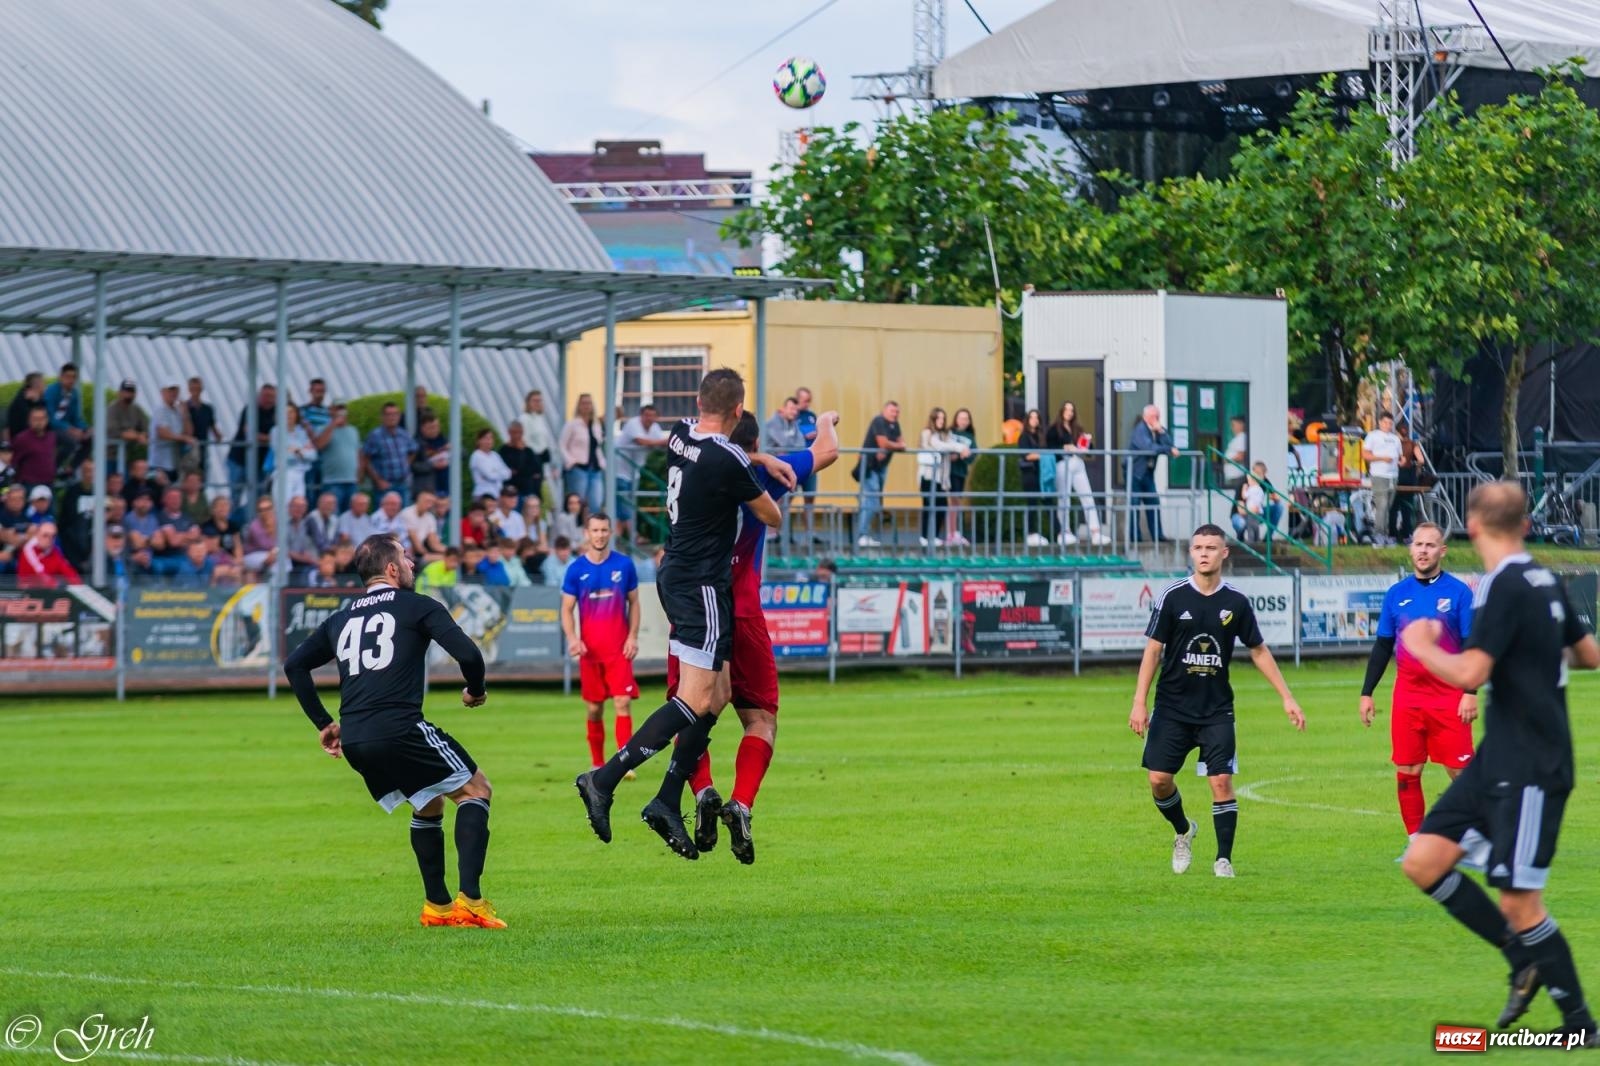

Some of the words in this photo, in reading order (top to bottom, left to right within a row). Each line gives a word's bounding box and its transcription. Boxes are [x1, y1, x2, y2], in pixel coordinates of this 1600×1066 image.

[666, 465, 683, 525] 8
[350, 590, 396, 611] LUBOMIA
[975, 589, 1014, 608] PRACA
[1013, 589, 1026, 608] W
[336, 611, 396, 676] 43
[1181, 652, 1223, 668] JANETA
